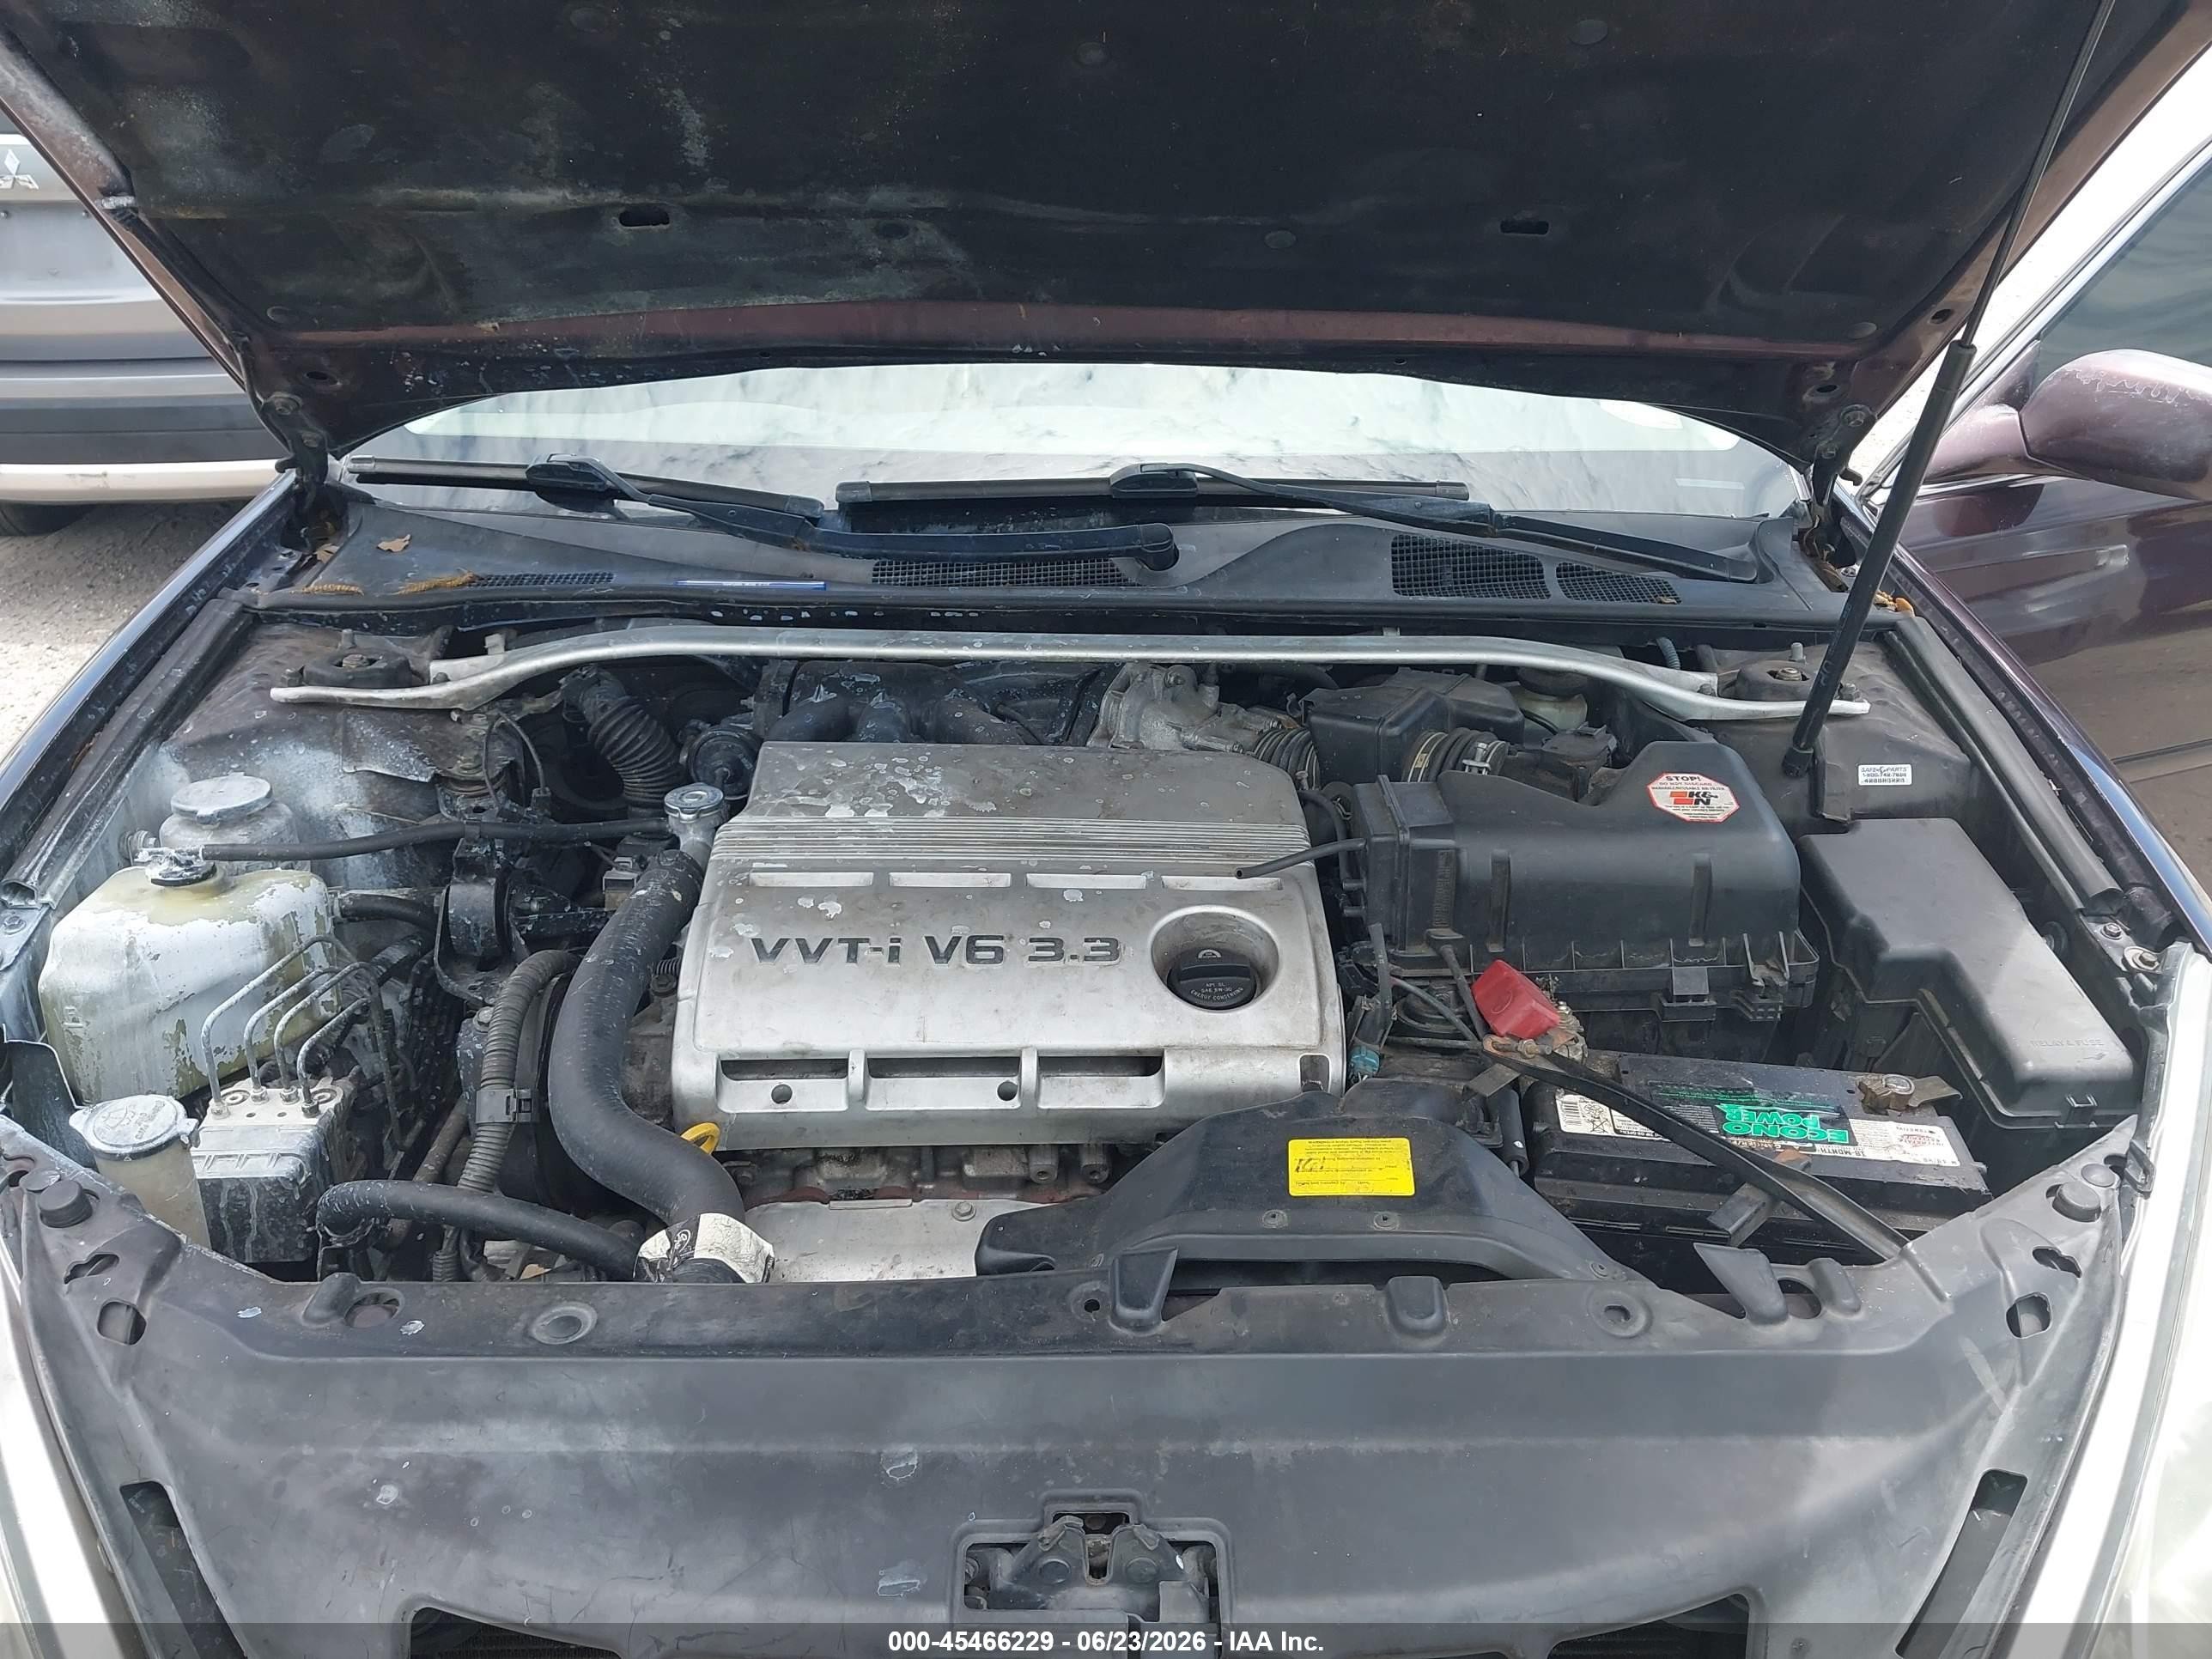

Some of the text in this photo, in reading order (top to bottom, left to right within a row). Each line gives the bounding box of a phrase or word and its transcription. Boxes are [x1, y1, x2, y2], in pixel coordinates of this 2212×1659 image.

[750, 935, 1120, 964] VVT-i V6 3.3
[1726, 1109, 1820, 1128] POWER
[1723, 1121, 1849, 1143] ECONO
[1820, 1147, 1866, 1157] 18-MONTH
